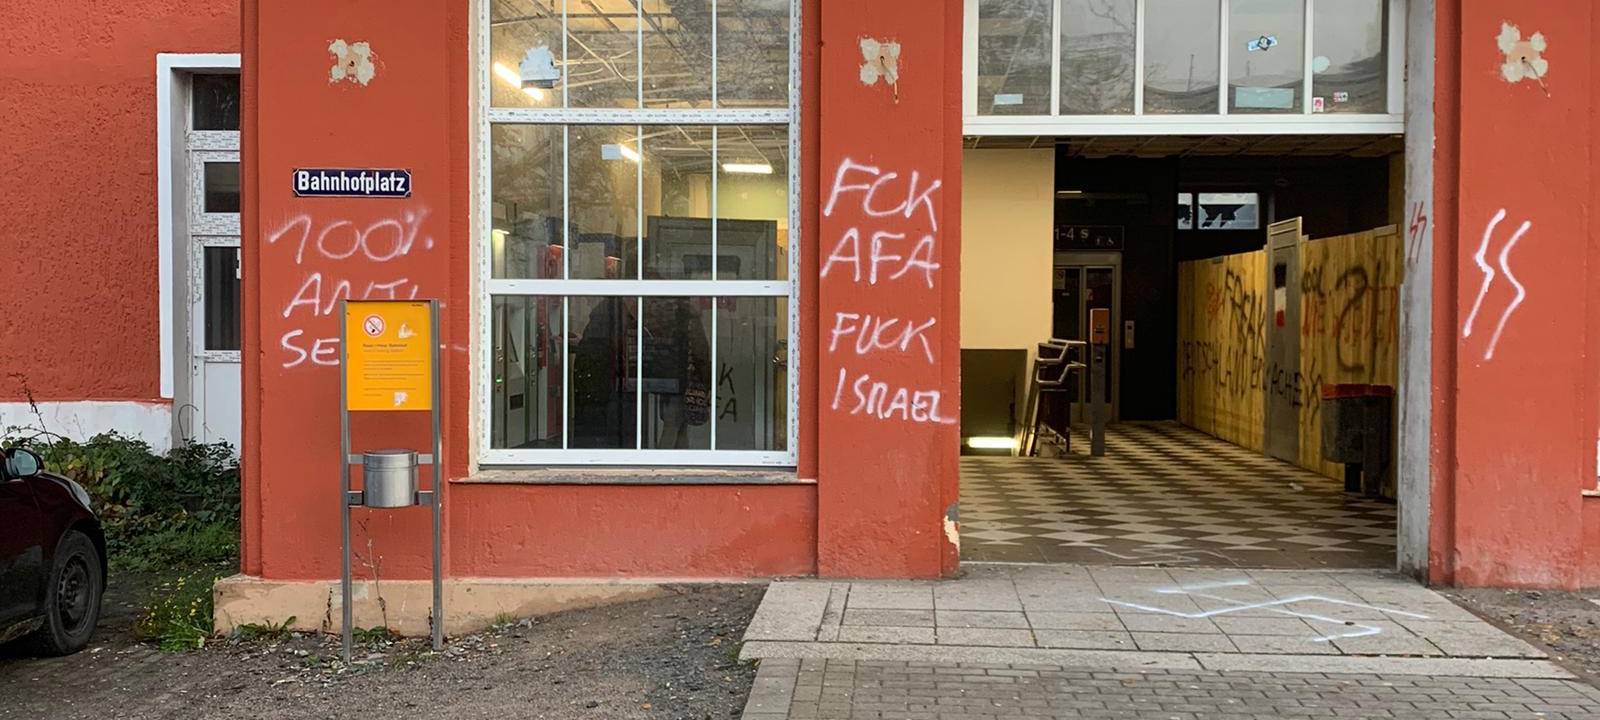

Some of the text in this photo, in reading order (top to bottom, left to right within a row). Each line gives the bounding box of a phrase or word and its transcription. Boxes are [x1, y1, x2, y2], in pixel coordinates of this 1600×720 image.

[298, 170, 406, 195] Bahnhofplatz
[823, 157, 942, 232] FCK
[269, 208, 434, 264] 100%
[820, 227, 940, 288] AFA
[281, 329, 341, 368] SE
[829, 312, 936, 364] FUCK
[831, 367, 957, 423] ISRAEL
